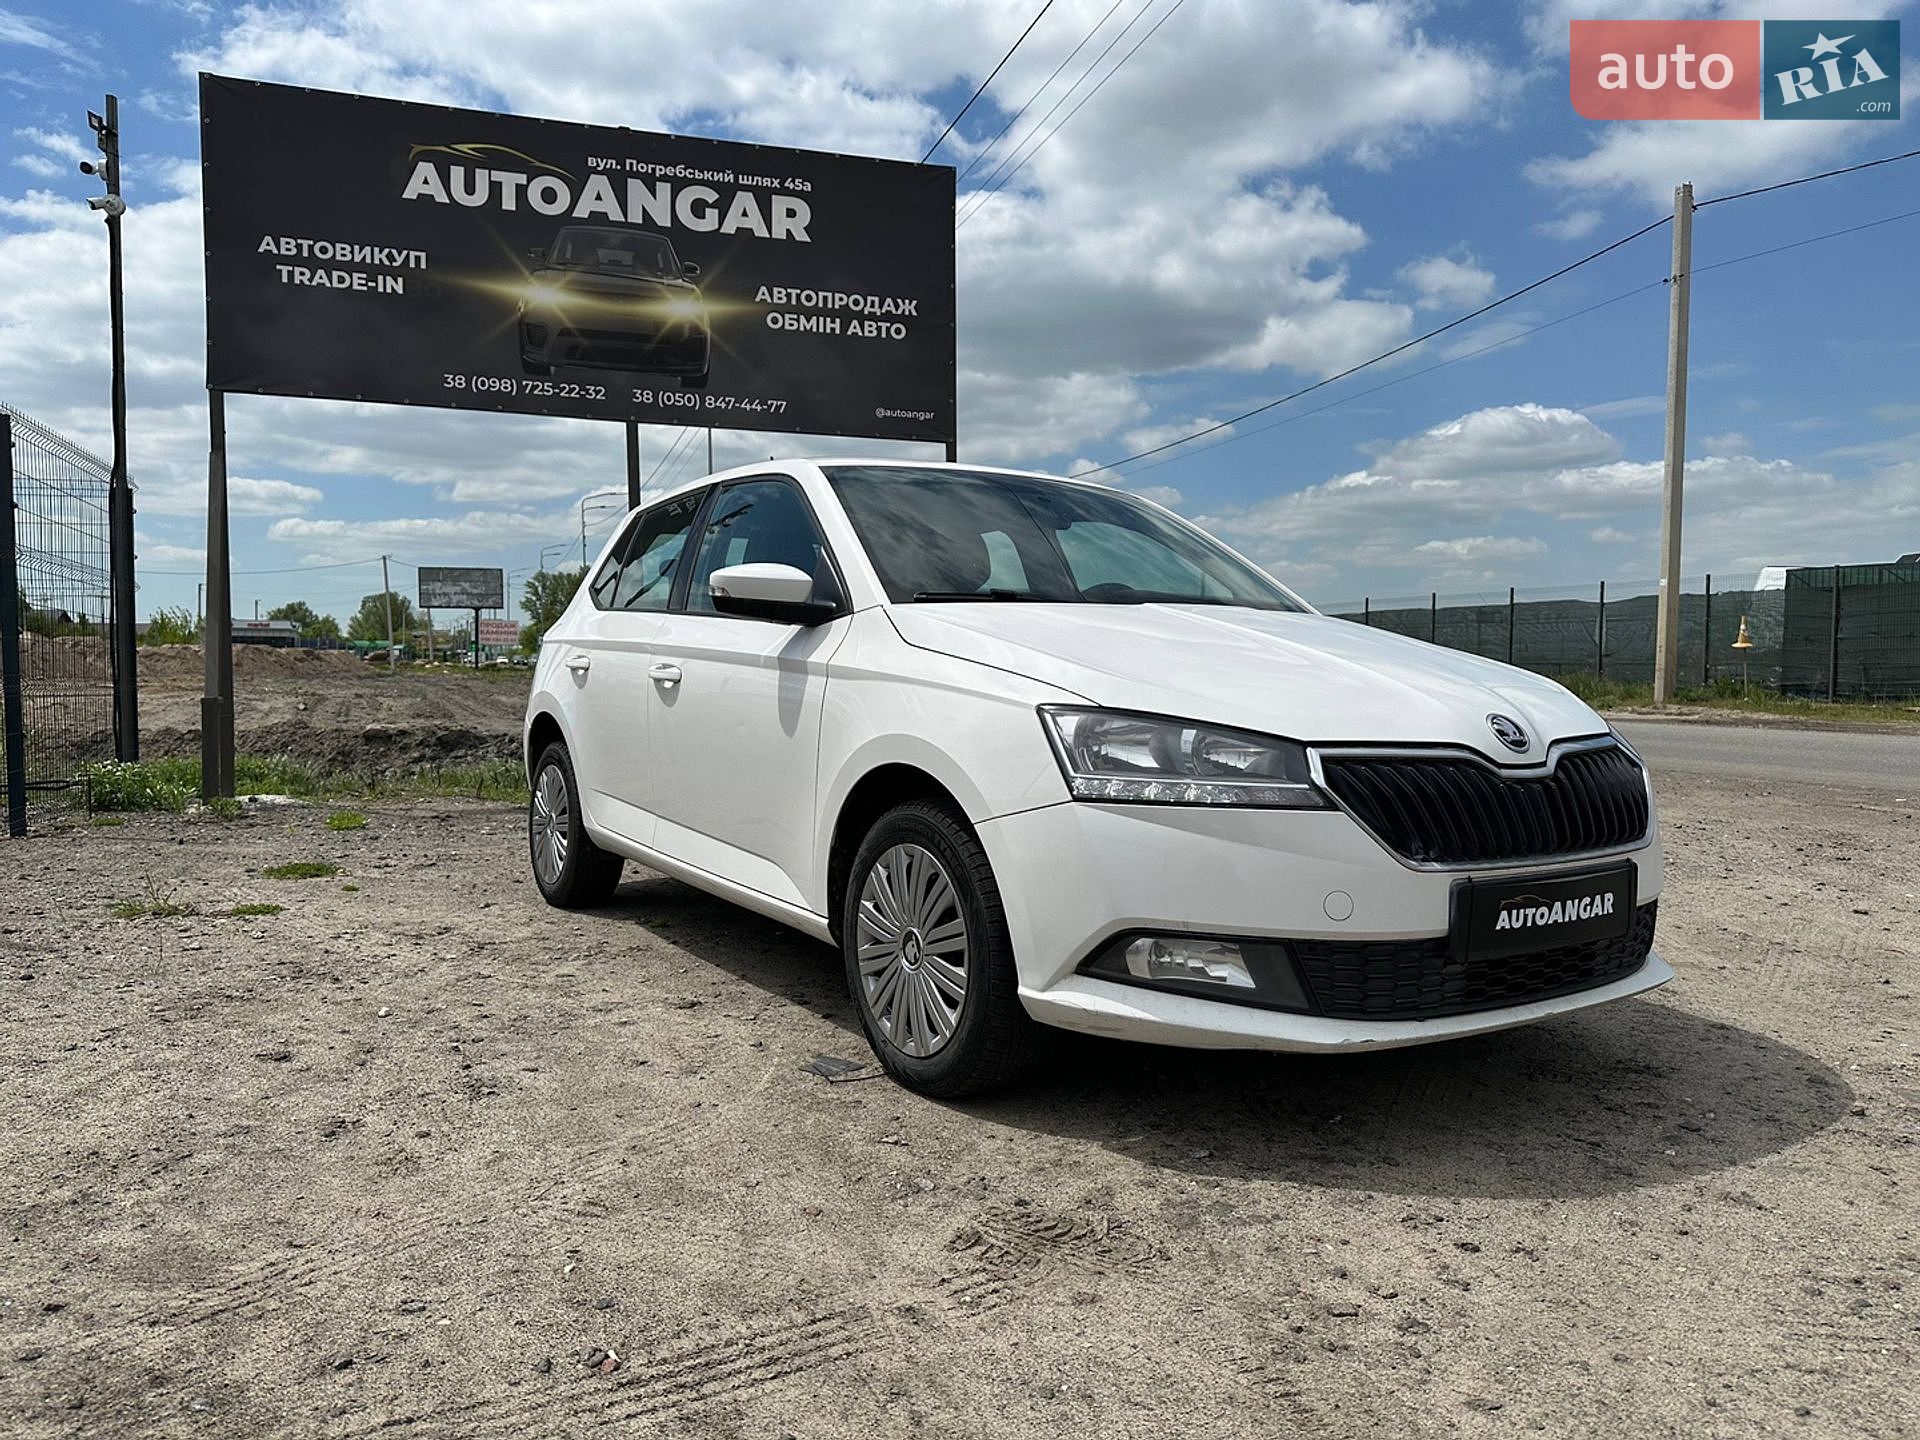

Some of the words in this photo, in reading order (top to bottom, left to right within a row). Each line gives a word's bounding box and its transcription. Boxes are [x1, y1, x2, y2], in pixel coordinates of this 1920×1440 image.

[587, 156, 622, 171] вул.
[625, 158, 736, 183] Погребський
[738, 174, 781, 189] шлях
[257, 235, 427, 270] АВТОВИКУП
[275, 264, 404, 295] TRADE-IN
[754, 285, 918, 317] АВТОПРОДАЖ
[766, 311, 841, 335] ОБМІН
[846, 319, 907, 340] АВТО
[443, 373, 467, 389] 38
[471, 375, 517, 396] (098)
[522, 380, 606, 400] 725-22-32
[632, 389, 654, 404] 38
[658, 390, 700, 411] (050)
[704, 395, 787, 414] 847-44-77
[874, 407, 935, 421] @autoangar
[1495, 892, 1615, 931] AUTOANGAR
